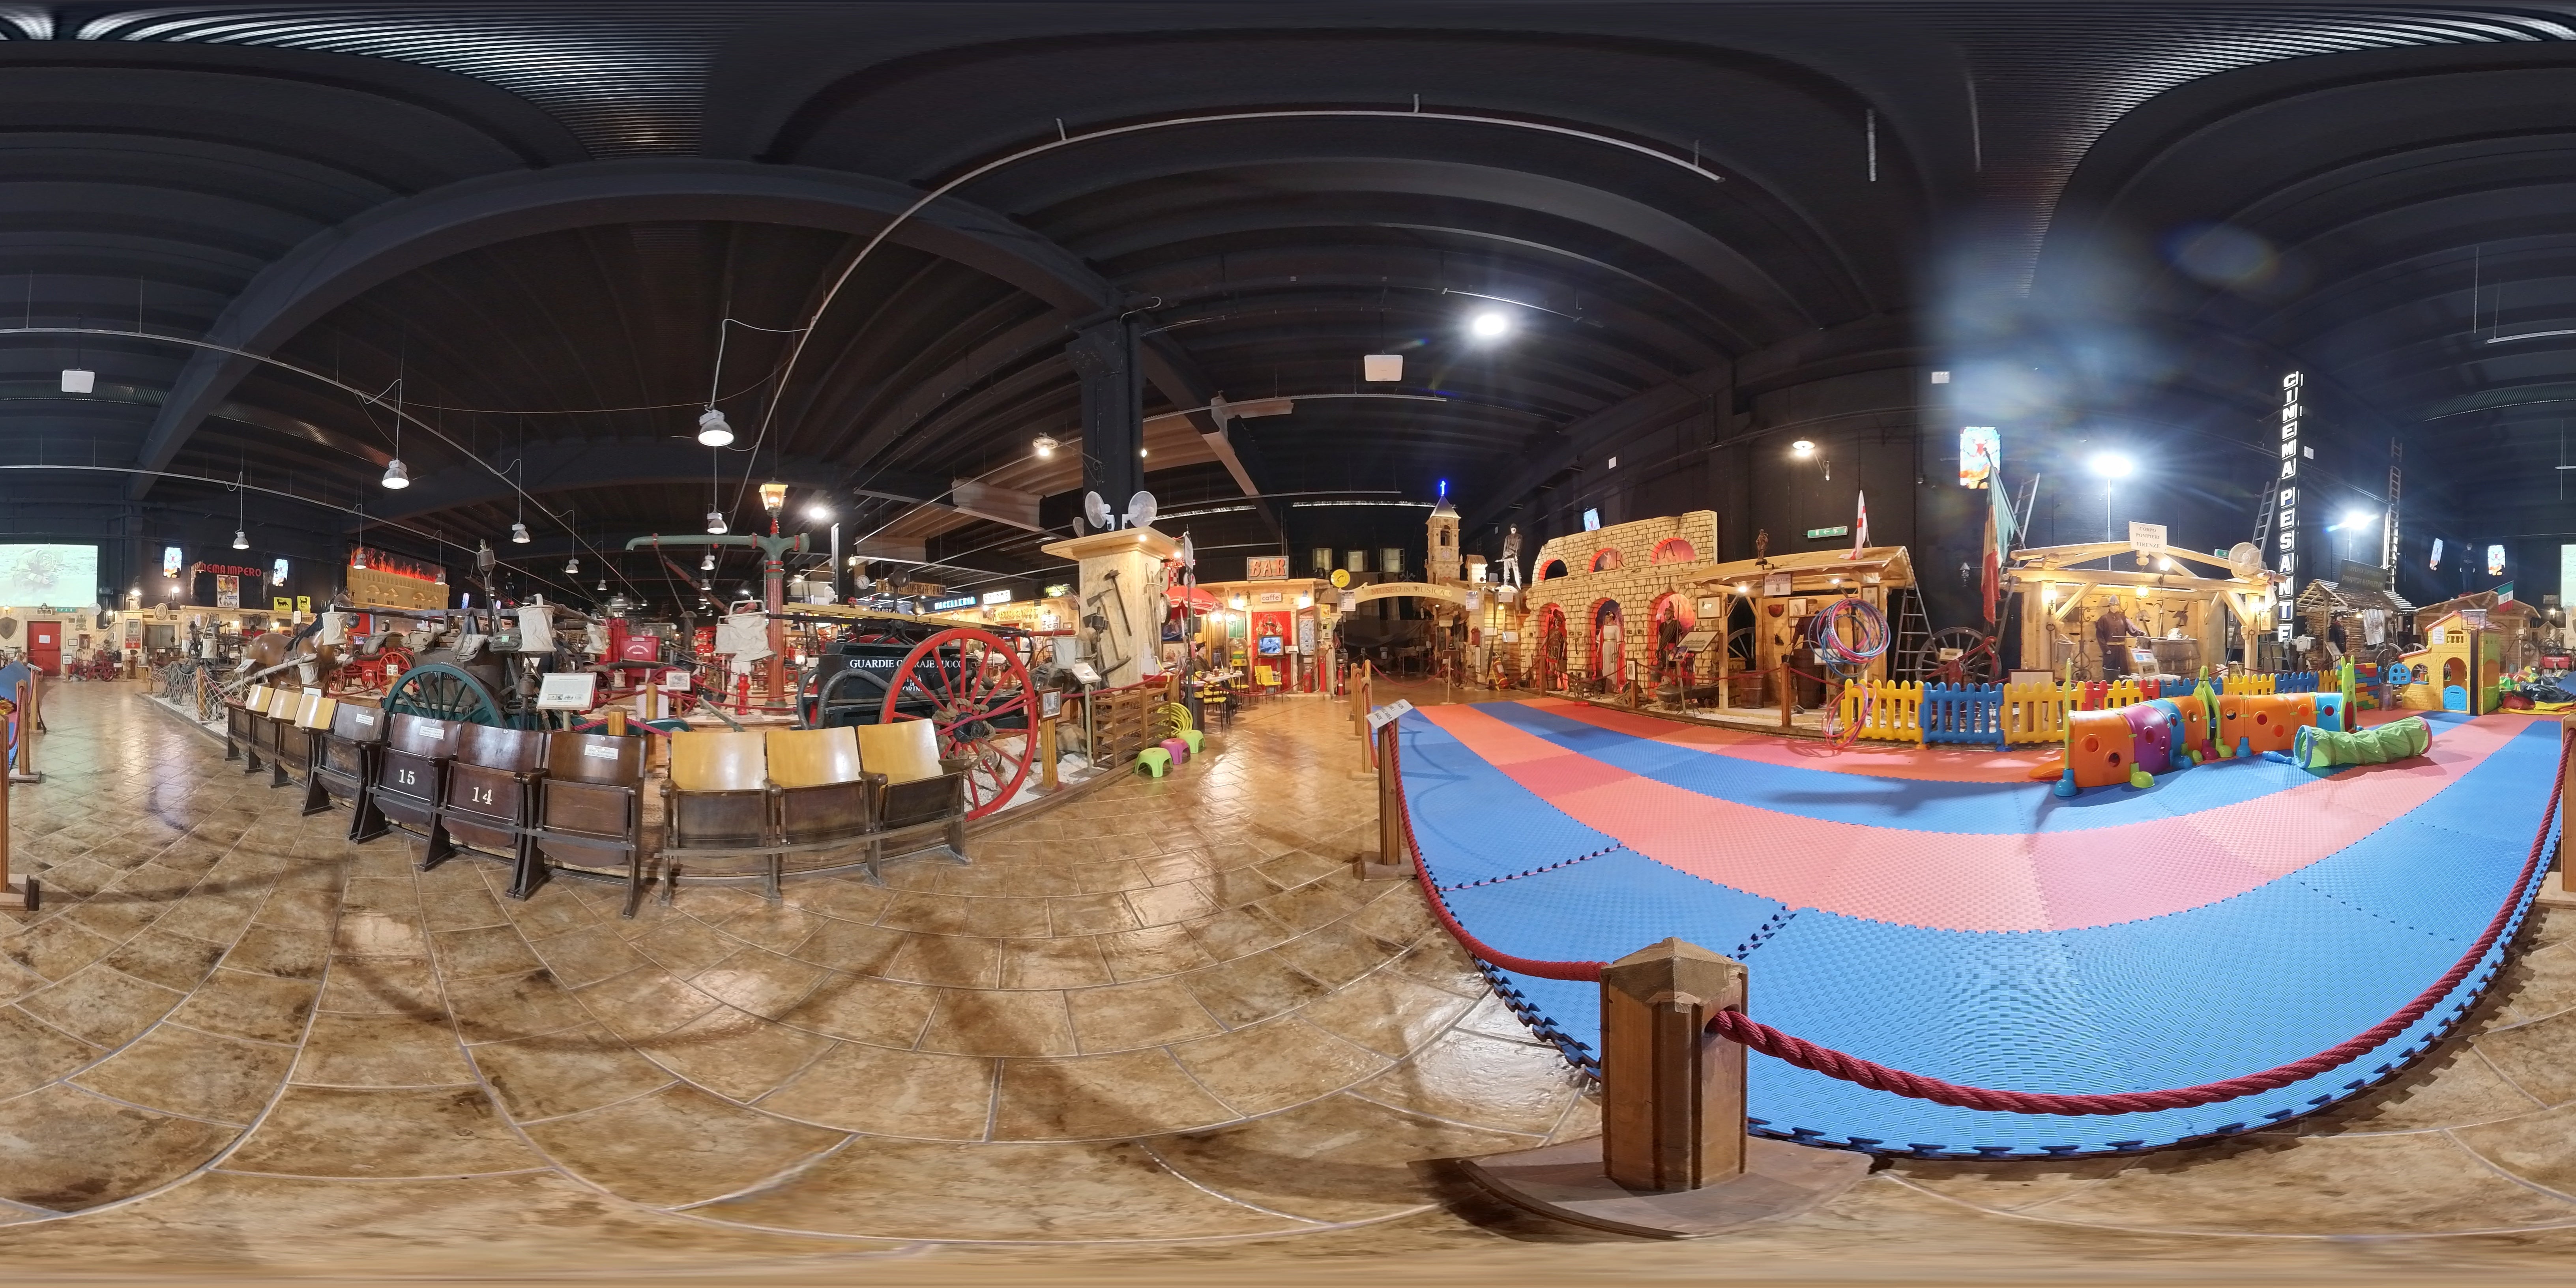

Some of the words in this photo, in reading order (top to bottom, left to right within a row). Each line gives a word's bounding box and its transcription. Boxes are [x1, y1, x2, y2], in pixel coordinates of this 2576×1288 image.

[2281, 372, 2297, 478] CINEMA
[227, 565, 262, 577] IMPERO
[1250, 557, 1286, 577] BAR
[2278, 488, 2294, 642] PESANTE
[1371, 586, 1401, 595] MUSEO
[1413, 586, 1445, 595] MUSICA
[934, 596, 976, 610] MACELLERIA
[995, 608, 1038, 619] RISTORANTE
[850, 659, 895, 668] GUARDIE
[1374, 712, 1383, 721] RAZIE
[399, 769, 415, 785] 15
[472, 786, 493, 805] 14
